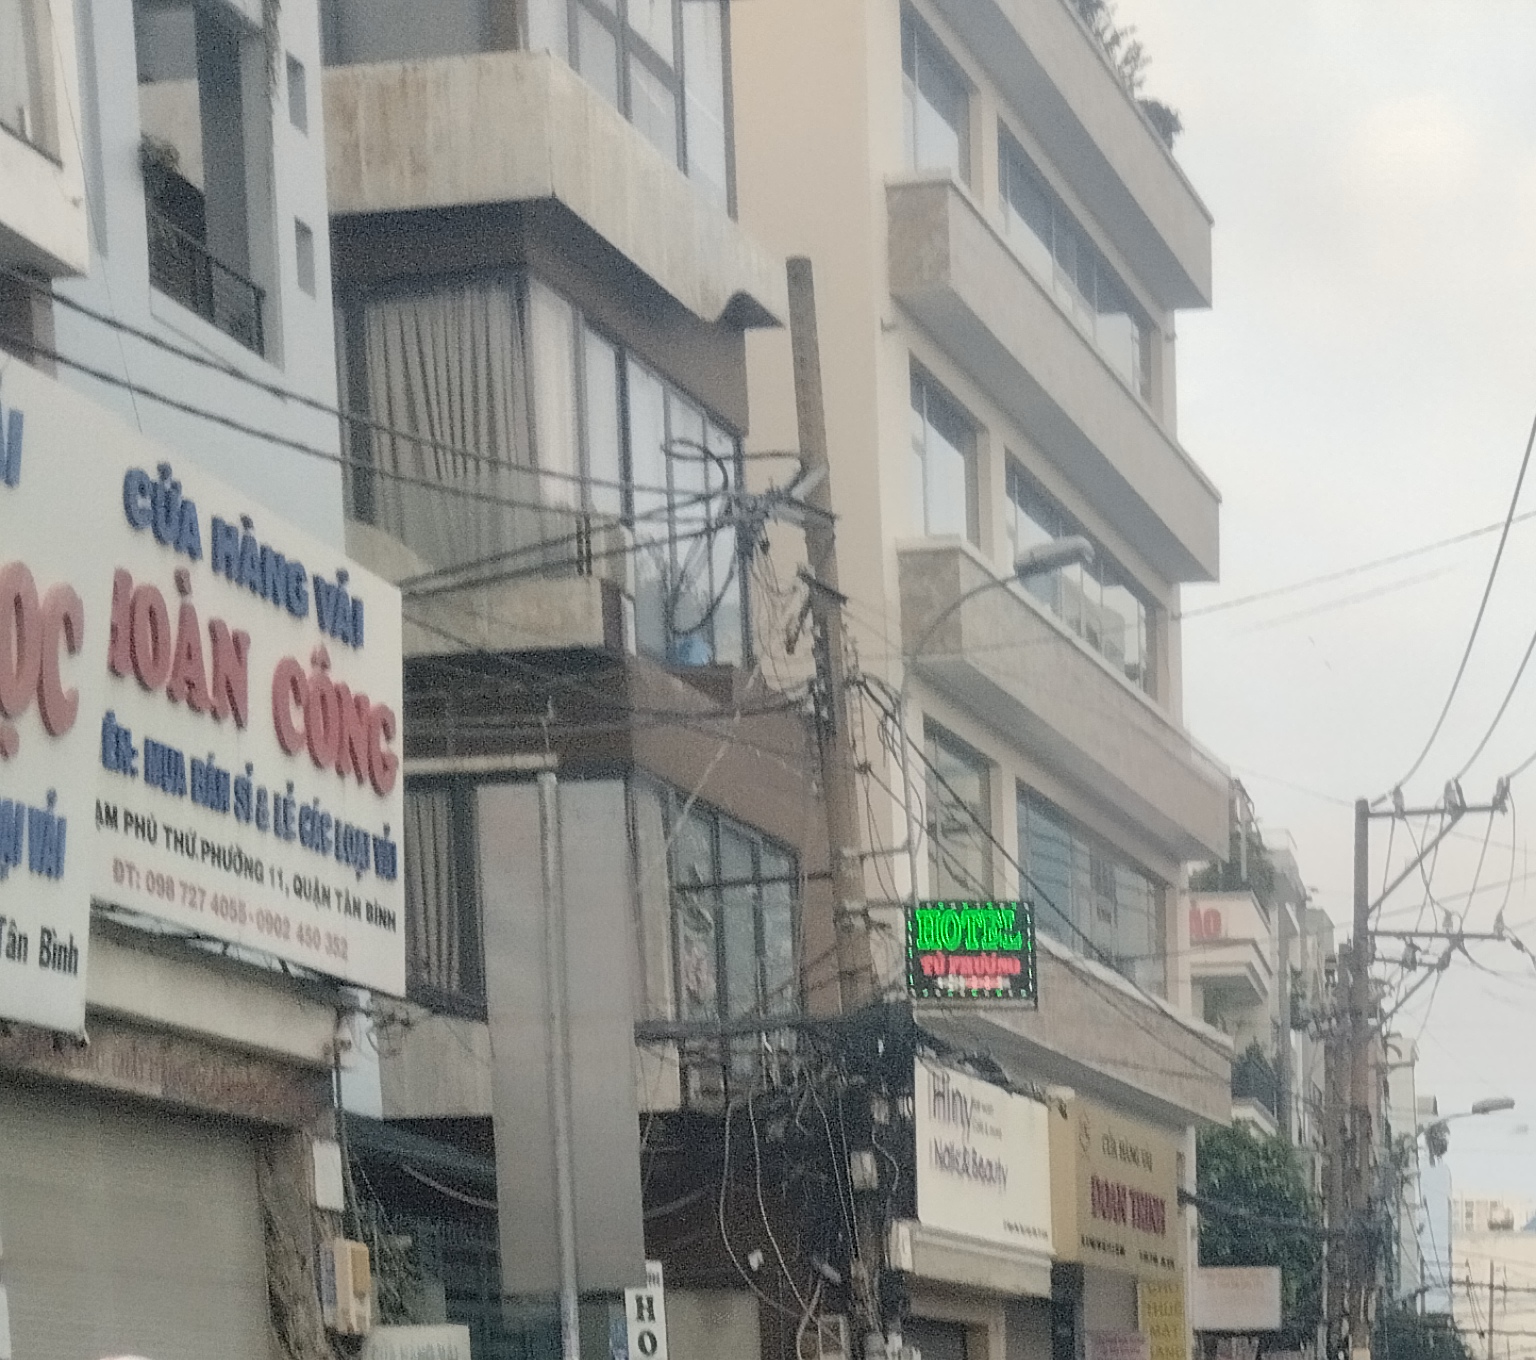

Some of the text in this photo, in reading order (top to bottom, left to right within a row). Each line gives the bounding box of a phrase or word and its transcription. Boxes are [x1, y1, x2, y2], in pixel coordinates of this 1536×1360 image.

[122, 461, 203, 561] CỬA
[211, 512, 309, 618] HÀNG
[272, 643, 399, 797] CÔNG
[916, 908, 1022, 951] HOTEL
